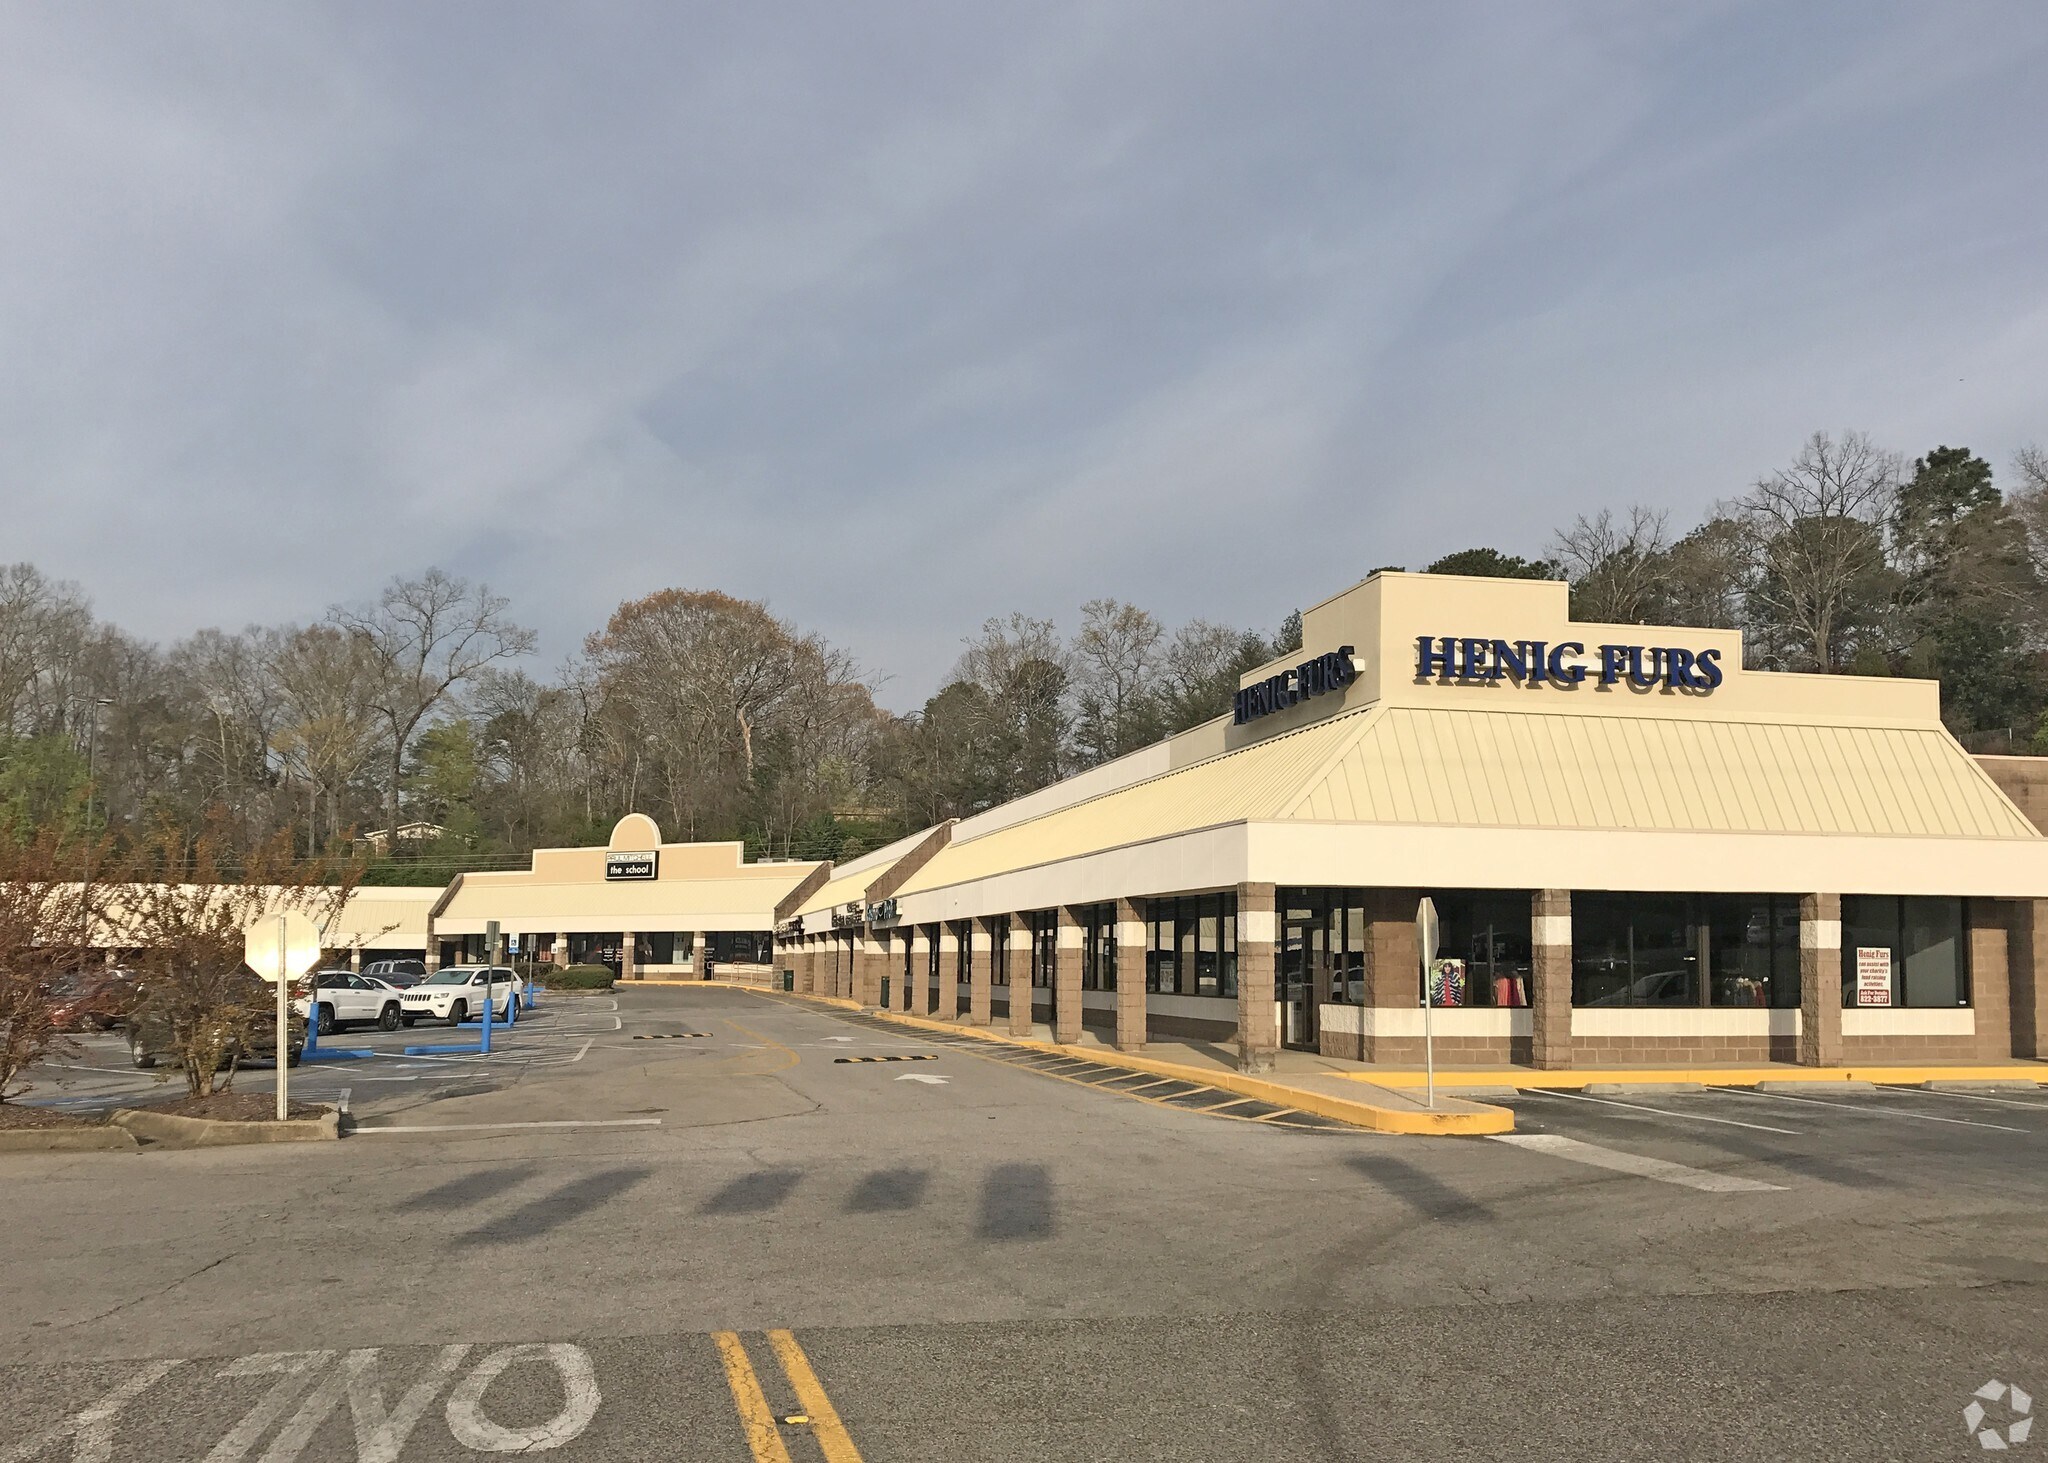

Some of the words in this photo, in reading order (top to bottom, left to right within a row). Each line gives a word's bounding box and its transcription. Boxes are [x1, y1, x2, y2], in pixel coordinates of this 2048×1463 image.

[1415, 636, 1587, 683] HENIG
[1598, 644, 1723, 690] FURS
[1233, 669, 1298, 726] HENIG
[1296, 645, 1356, 701] FURS
[610, 865, 623, 874] the
[625, 864, 649, 874] school
[1858, 950, 1875, 959] Henig
[1876, 950, 1889, 958] Furs
